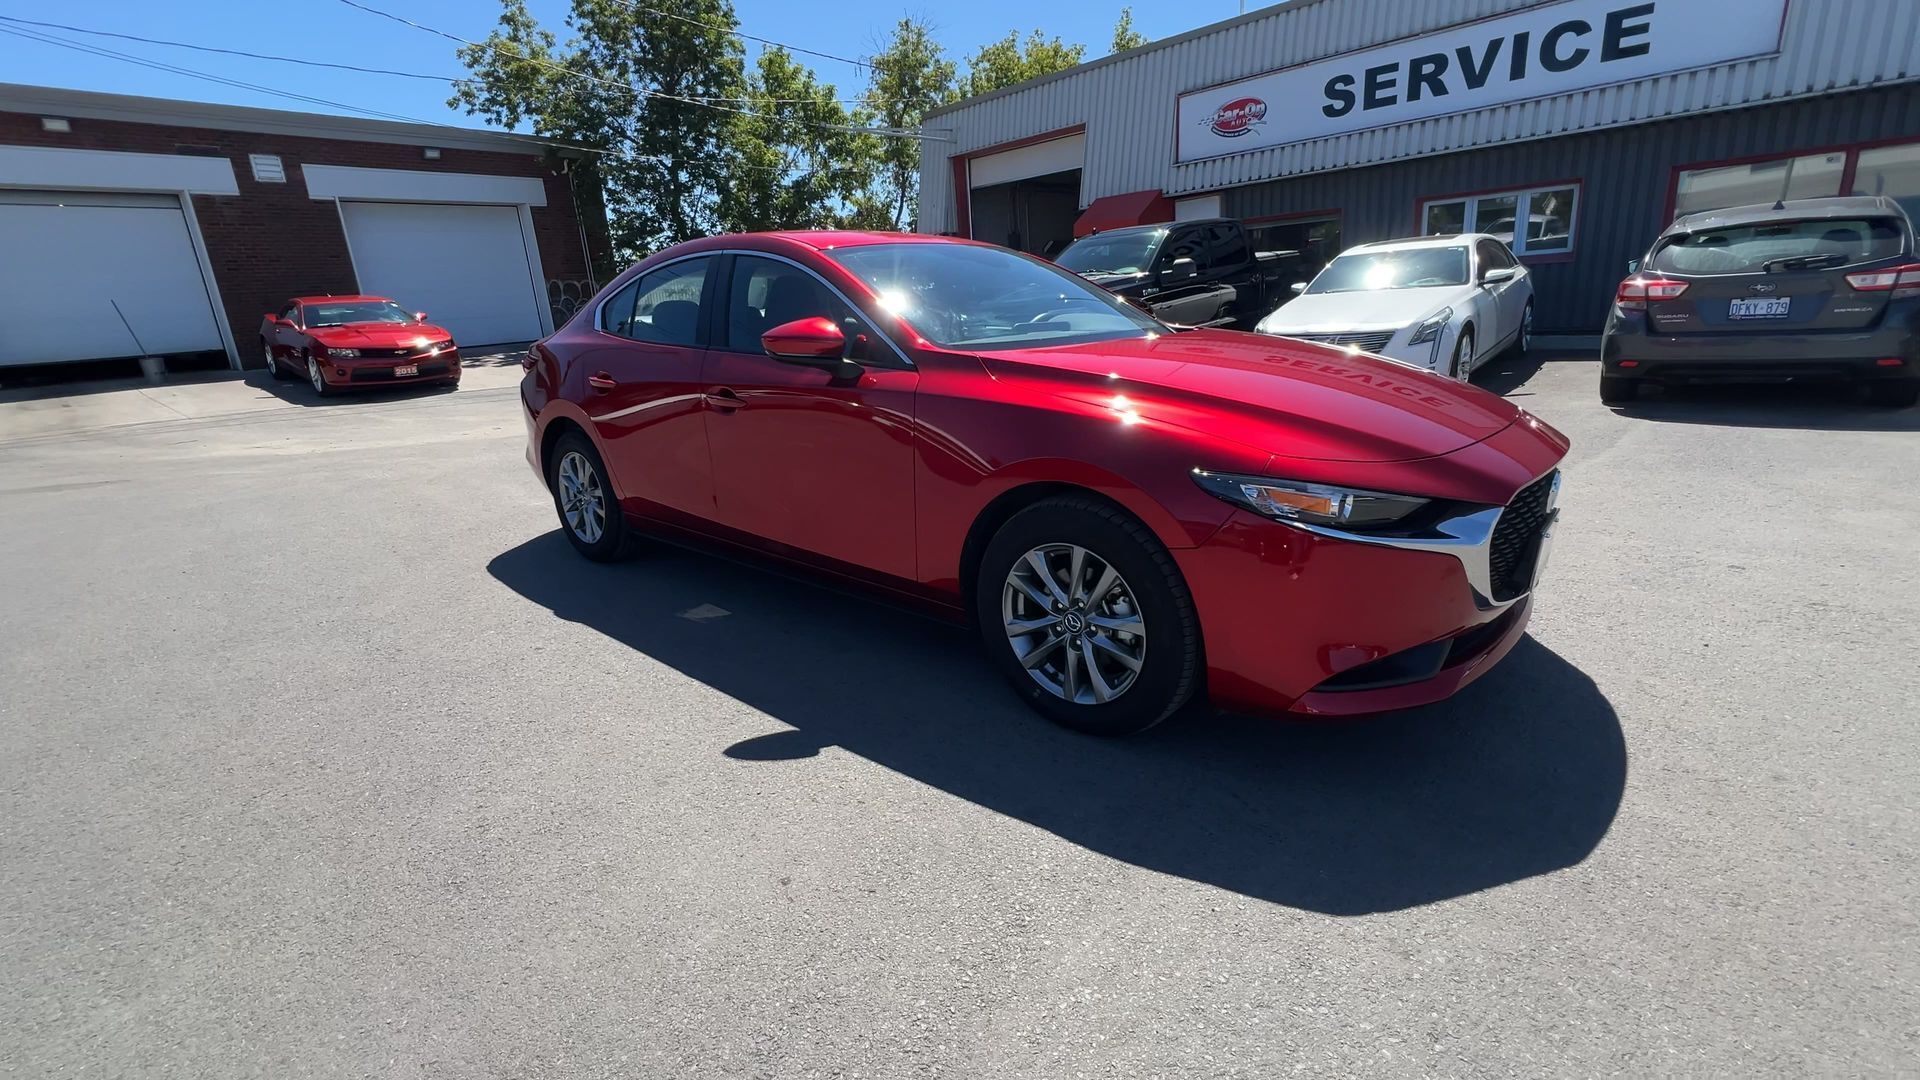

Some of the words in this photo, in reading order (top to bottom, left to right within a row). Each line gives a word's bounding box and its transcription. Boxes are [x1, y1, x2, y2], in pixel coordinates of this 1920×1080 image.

[1322, 2, 1655, 118] SERVICE
[1766, 302, 1788, 314] 879
[395, 366, 417, 375] 2015
